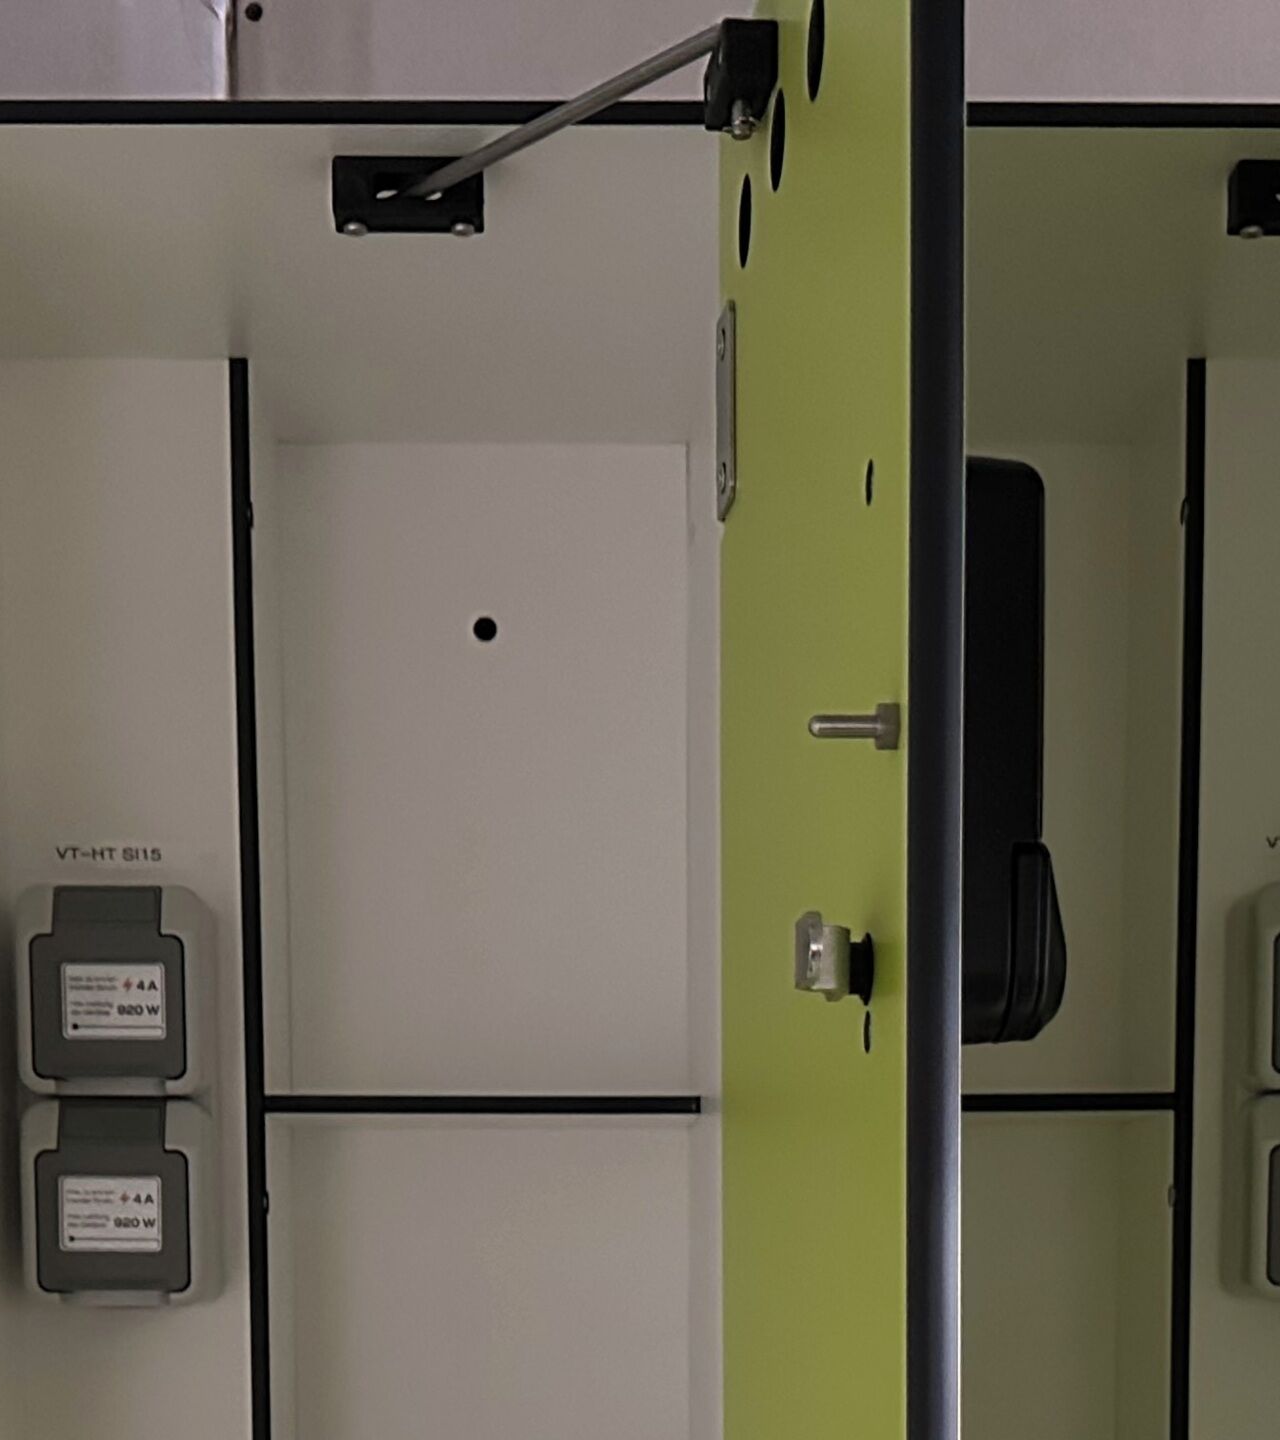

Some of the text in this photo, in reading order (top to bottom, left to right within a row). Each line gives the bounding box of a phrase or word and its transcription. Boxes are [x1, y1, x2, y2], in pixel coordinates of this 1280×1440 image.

[136, 980, 158, 991] 4 A
[146, 1004, 160, 1016] W
[132, 1193, 154, 1204] 4 A
[142, 1217, 156, 1228] W
